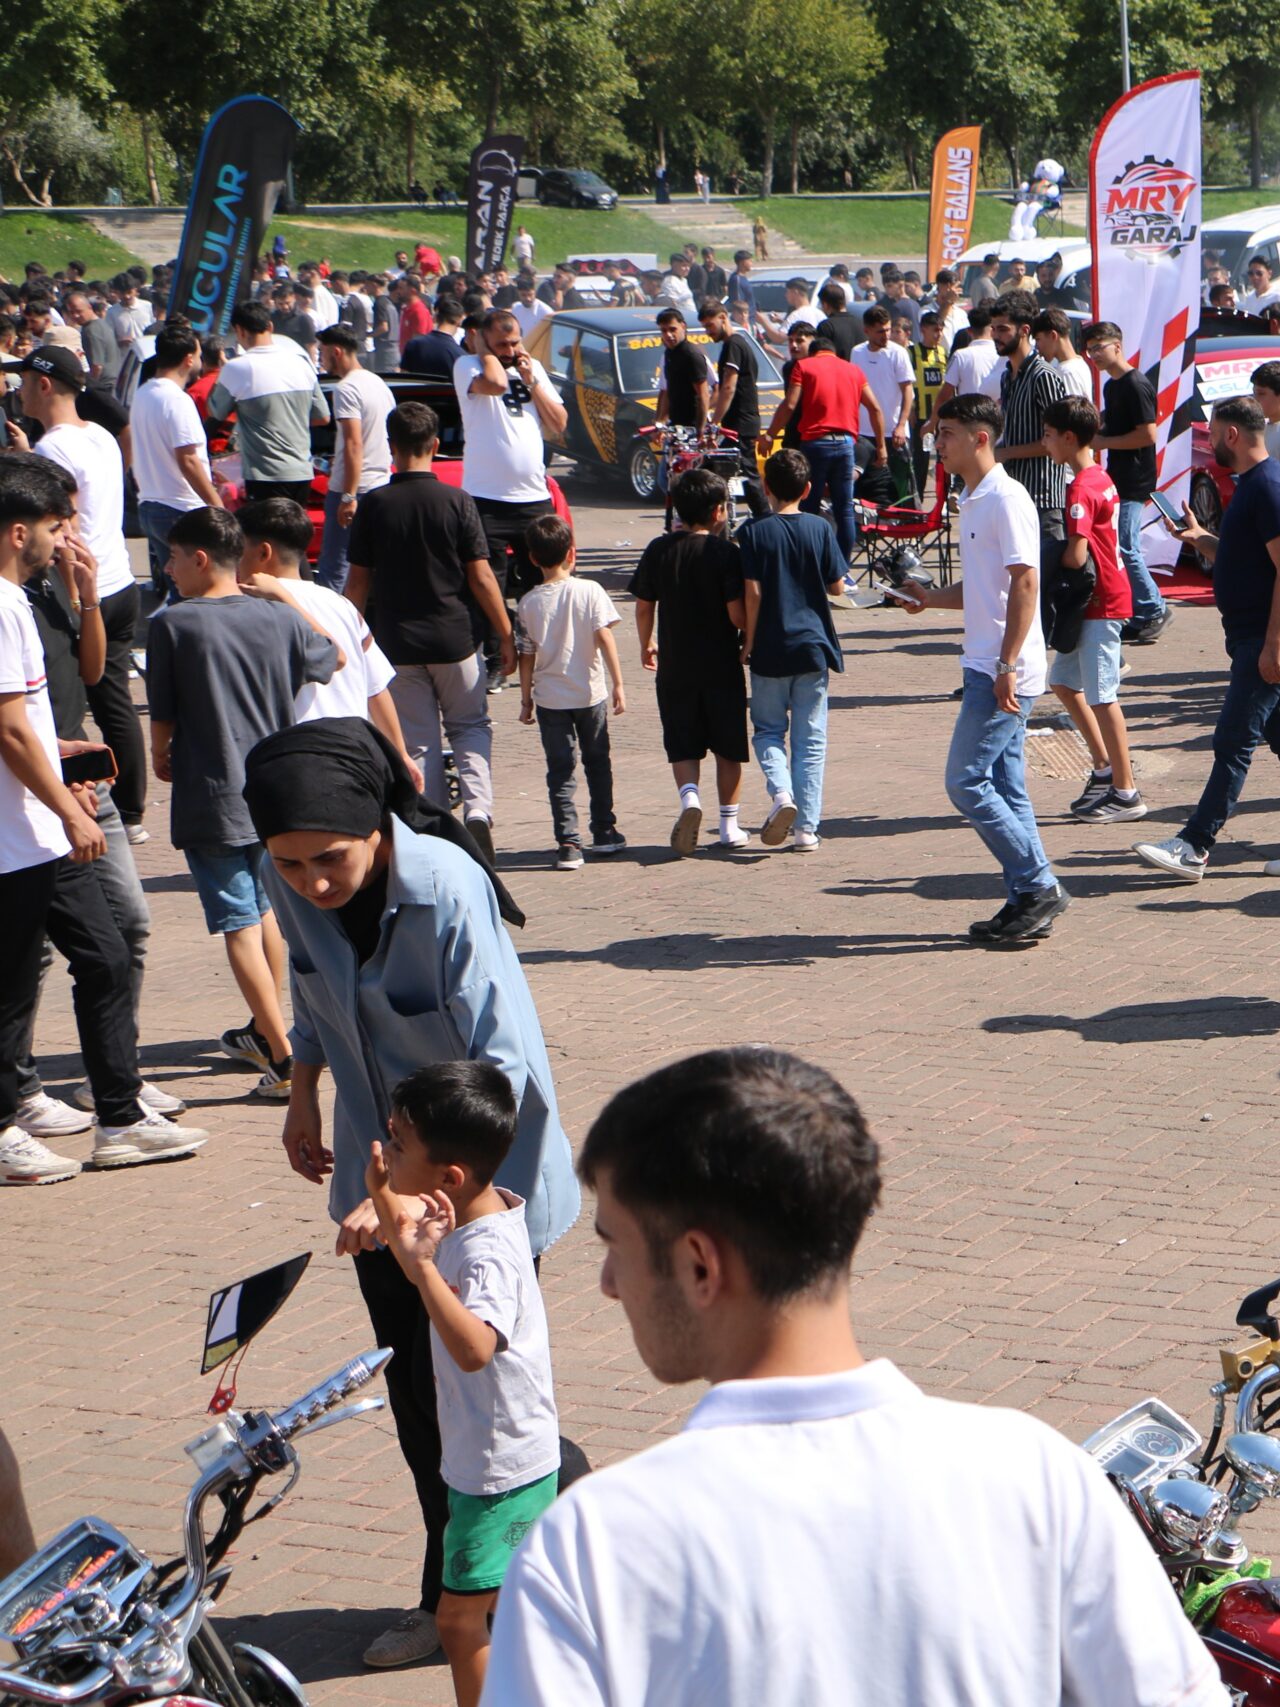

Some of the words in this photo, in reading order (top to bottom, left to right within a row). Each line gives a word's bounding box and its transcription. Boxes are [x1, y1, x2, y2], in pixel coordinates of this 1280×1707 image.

[944, 147, 973, 220] BALANS
[1105, 183, 1198, 214] MRY
[496, 185, 512, 229] PARÇA
[1110, 225, 1198, 245] GARAJ
[1204, 361, 1263, 378] MR
